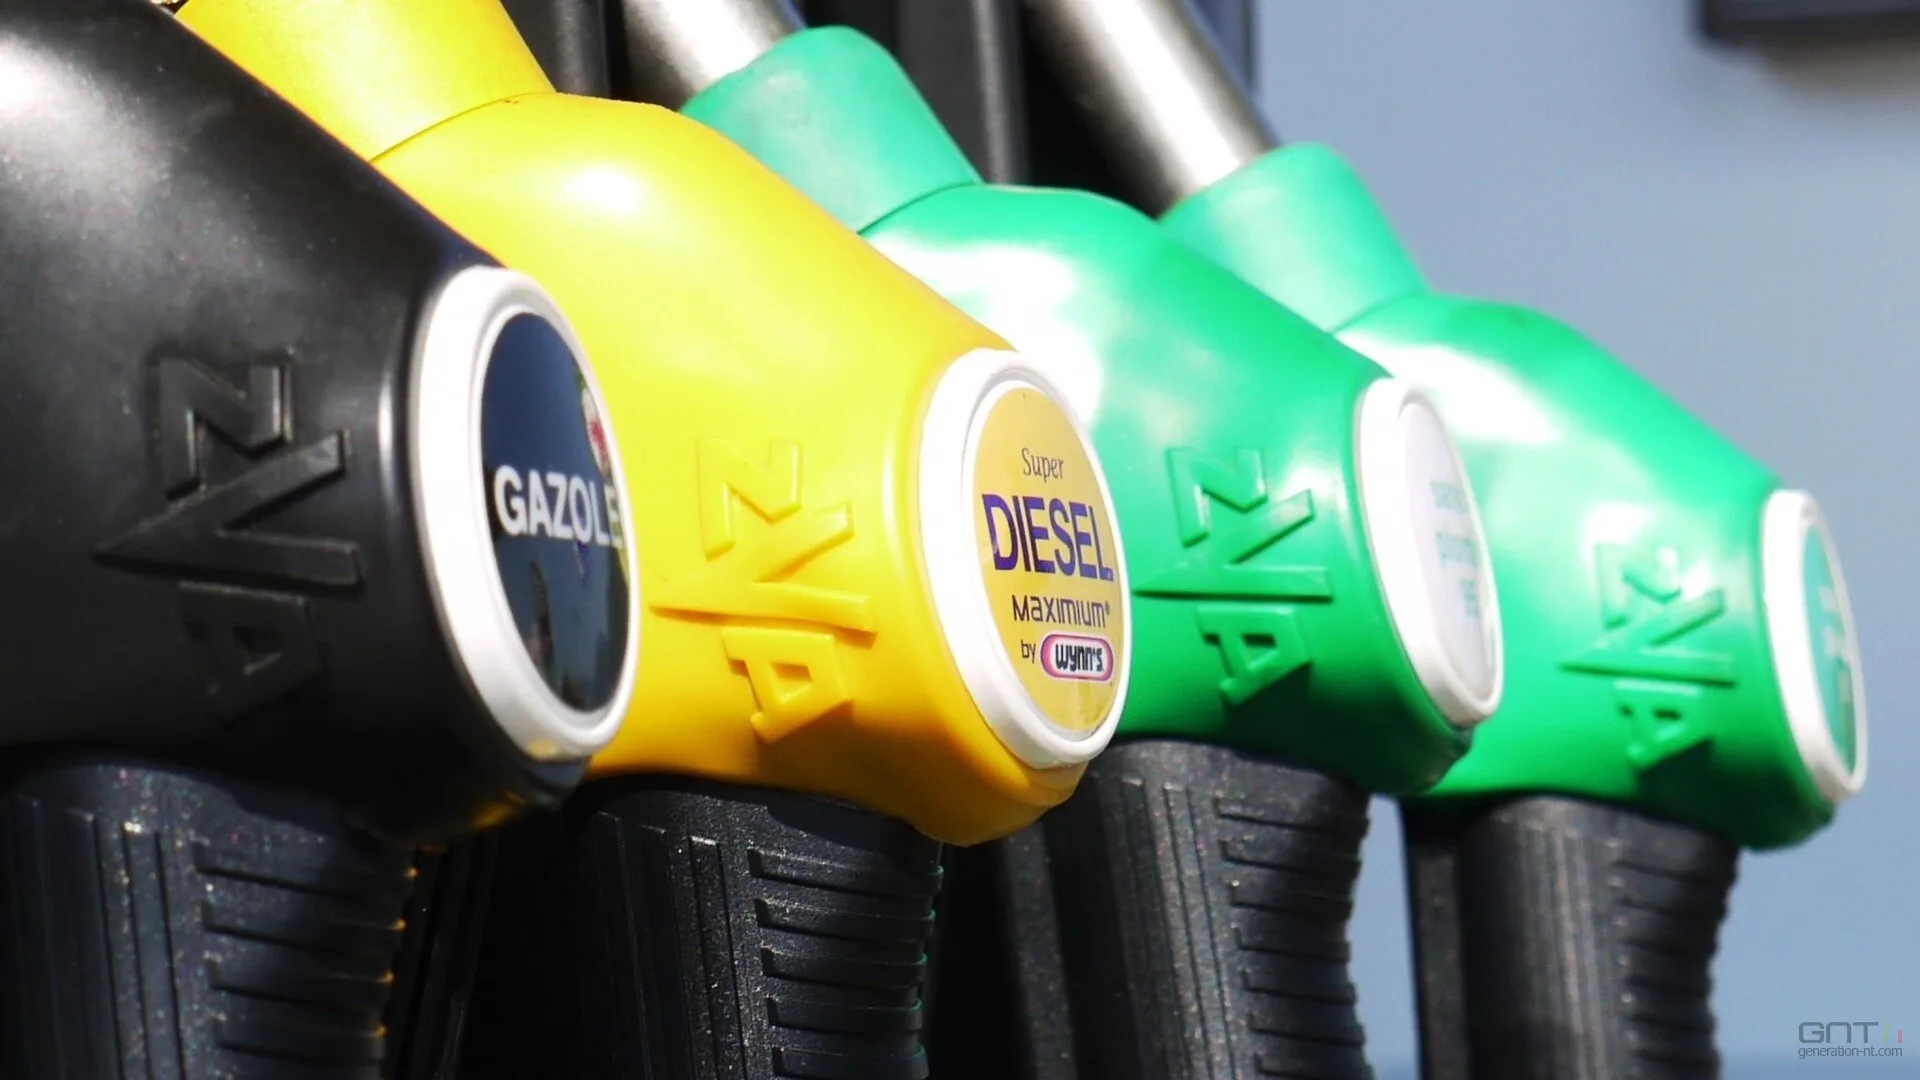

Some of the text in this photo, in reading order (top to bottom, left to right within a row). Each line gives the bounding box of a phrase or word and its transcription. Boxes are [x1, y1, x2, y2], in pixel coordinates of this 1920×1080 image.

[1021, 447, 1064, 483] Super
[494, 464, 624, 550] GAZOLE
[982, 493, 1115, 582] DIESEL
[1020, 639, 1036, 664] by
